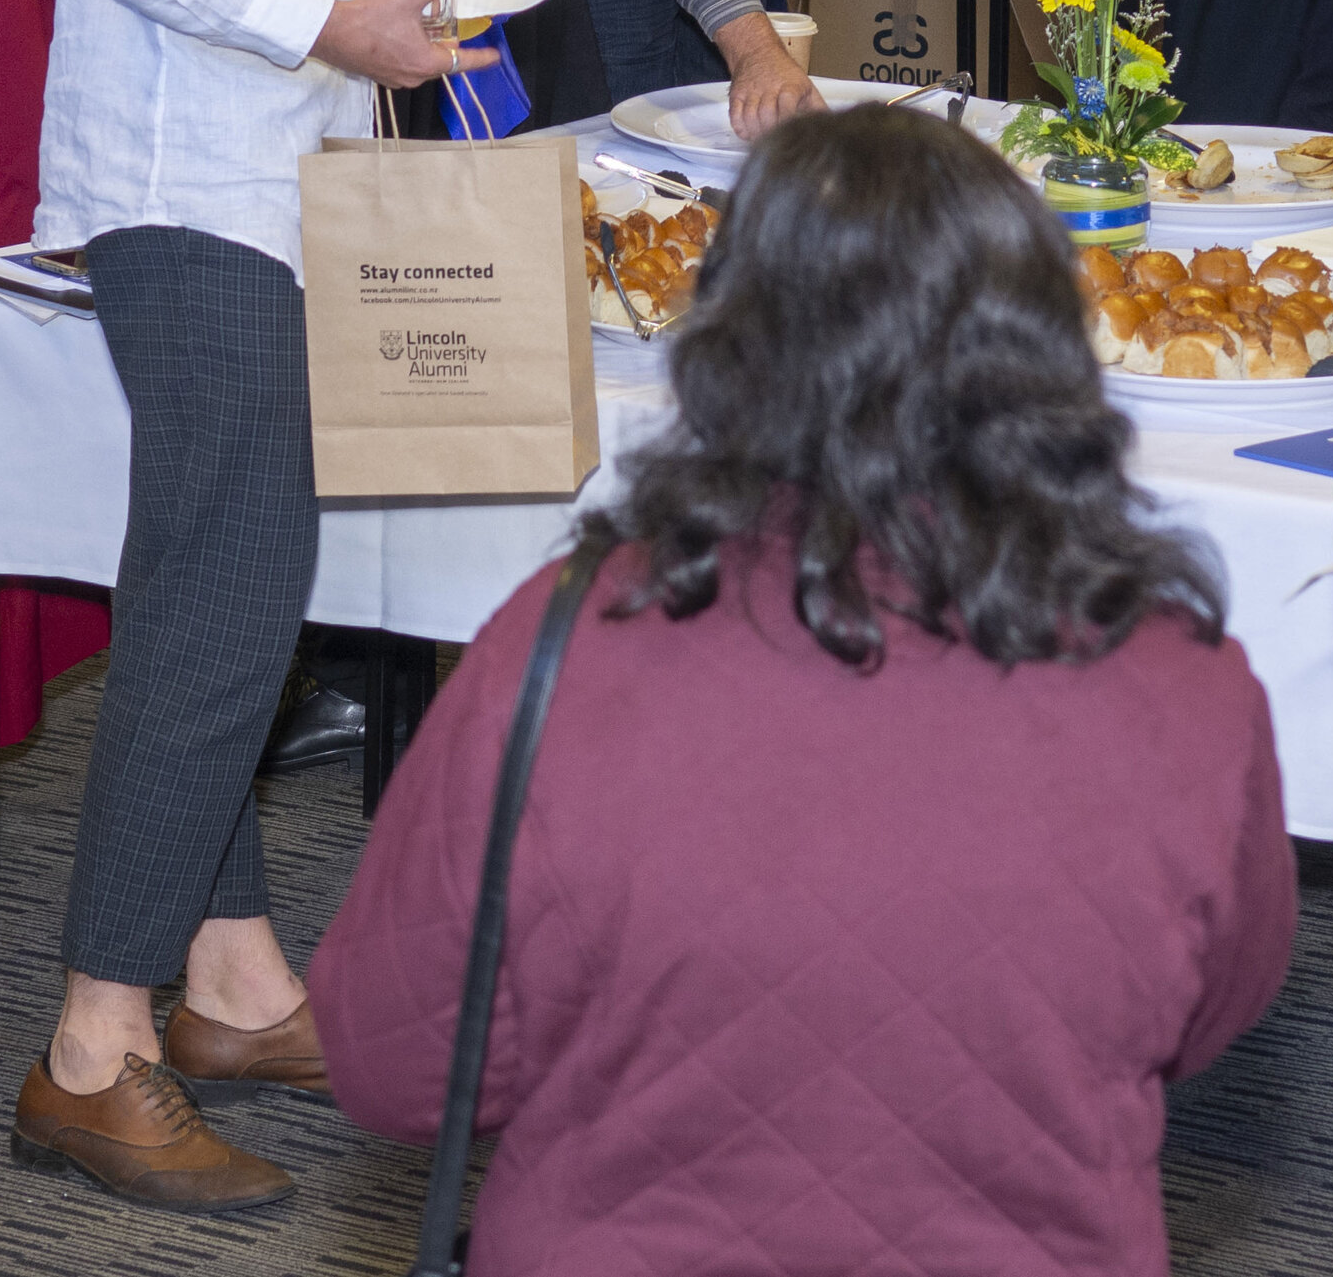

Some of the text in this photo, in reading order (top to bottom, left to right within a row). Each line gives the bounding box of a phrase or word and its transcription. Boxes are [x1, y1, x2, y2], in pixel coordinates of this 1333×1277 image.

[859, 62, 943, 87] colour
[360, 263, 494, 283] Stay connected
[360, 296, 502, 305] facebook.com/LincolnUniversityAlumni
[407, 330, 466, 345] Lincoln
[407, 345, 486, 364] University
[409, 361, 467, 376] Alumni
